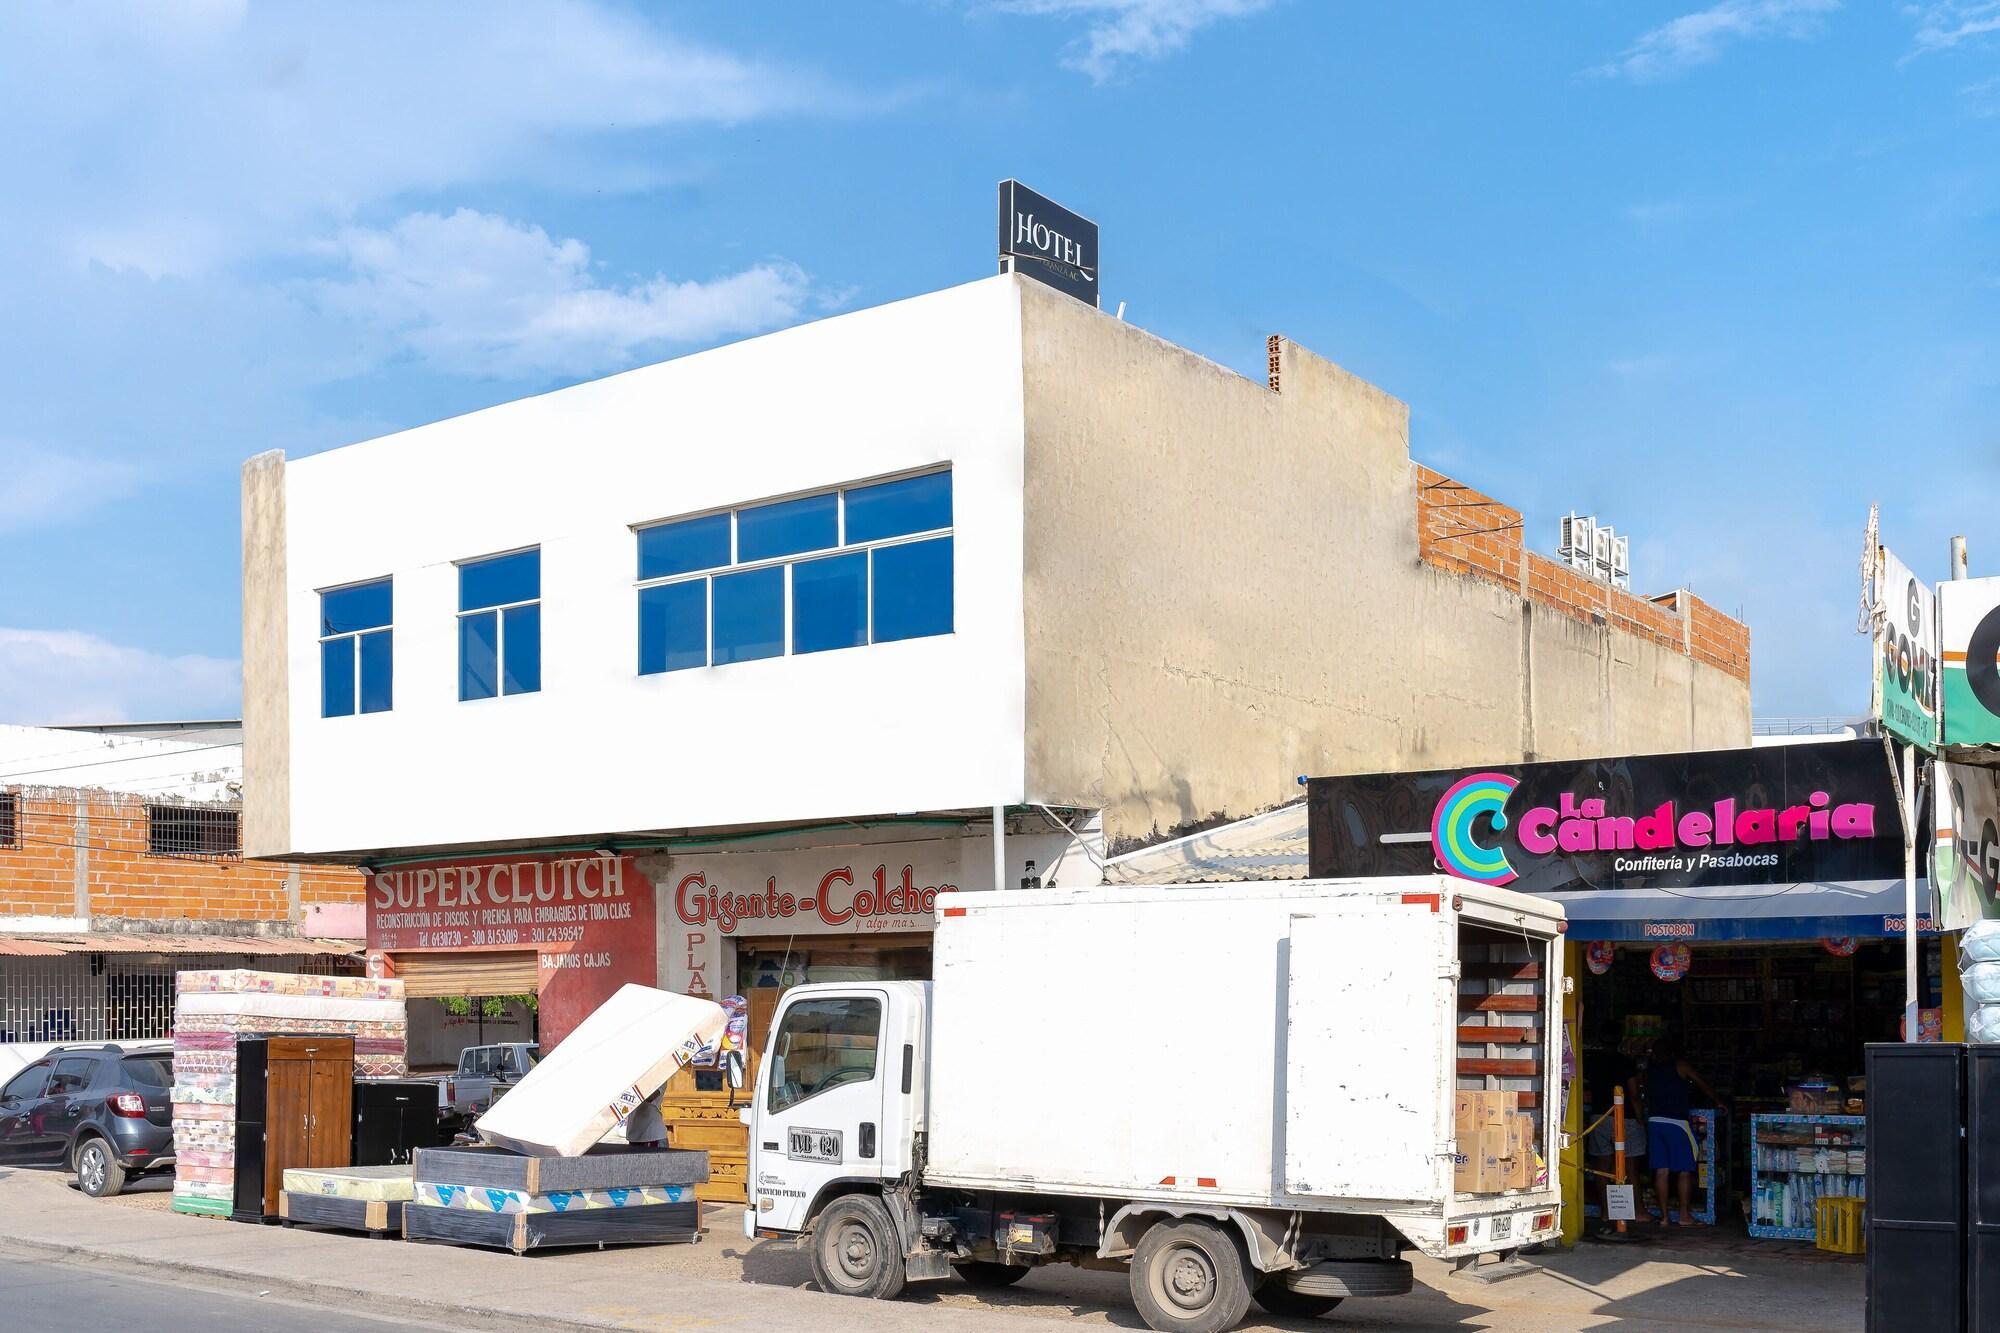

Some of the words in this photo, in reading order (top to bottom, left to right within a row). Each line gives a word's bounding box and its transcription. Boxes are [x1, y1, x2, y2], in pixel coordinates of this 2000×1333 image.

[1016, 211, 1094, 282] HOTEL
[1907, 577, 1920, 638] G
[1561, 793, 1605, 819] La
[1518, 790, 1875, 855] Candelaria
[1614, 856, 1683, 873] Confitería
[1686, 859, 1696, 874] y
[1698, 852, 1779, 870] Pasabocas
[375, 866, 481, 909] SUPER
[487, 857, 625, 904] CLUTCH
[674, 863, 961, 934] Gigante-Colcho
[433, 912, 442, 927] DE
[445, 910, 469, 927] DISCOS
[473, 910, 478, 925] Y
[482, 907, 511, 925] PRENSA
[514, 907, 533, 924] PARA
[534, 904, 576, 923] EMBRAGUES
[578, 904, 588, 920] DE
[589, 903, 609, 920] TODA
[609, 902, 631, 919] CLASE
[855, 920, 861, 933] y
[866, 918, 888, 933] algo
[471, 929, 486, 945] 300
[487, 927, 518, 944] 8153019
[531, 928, 545, 942] 301
[546, 925, 585, 942] 2439547
[1644, 923, 1695, 937] POSTOBON
[541, 953, 581, 969] BAJAMOS
[583, 952, 612, 968] CAJAS
[687, 933, 707, 994] PLA
[791, 1133, 813, 1154] TVB
[819, 1136, 839, 1157] 620
[757, 1188, 782, 1197] SERVICIO
